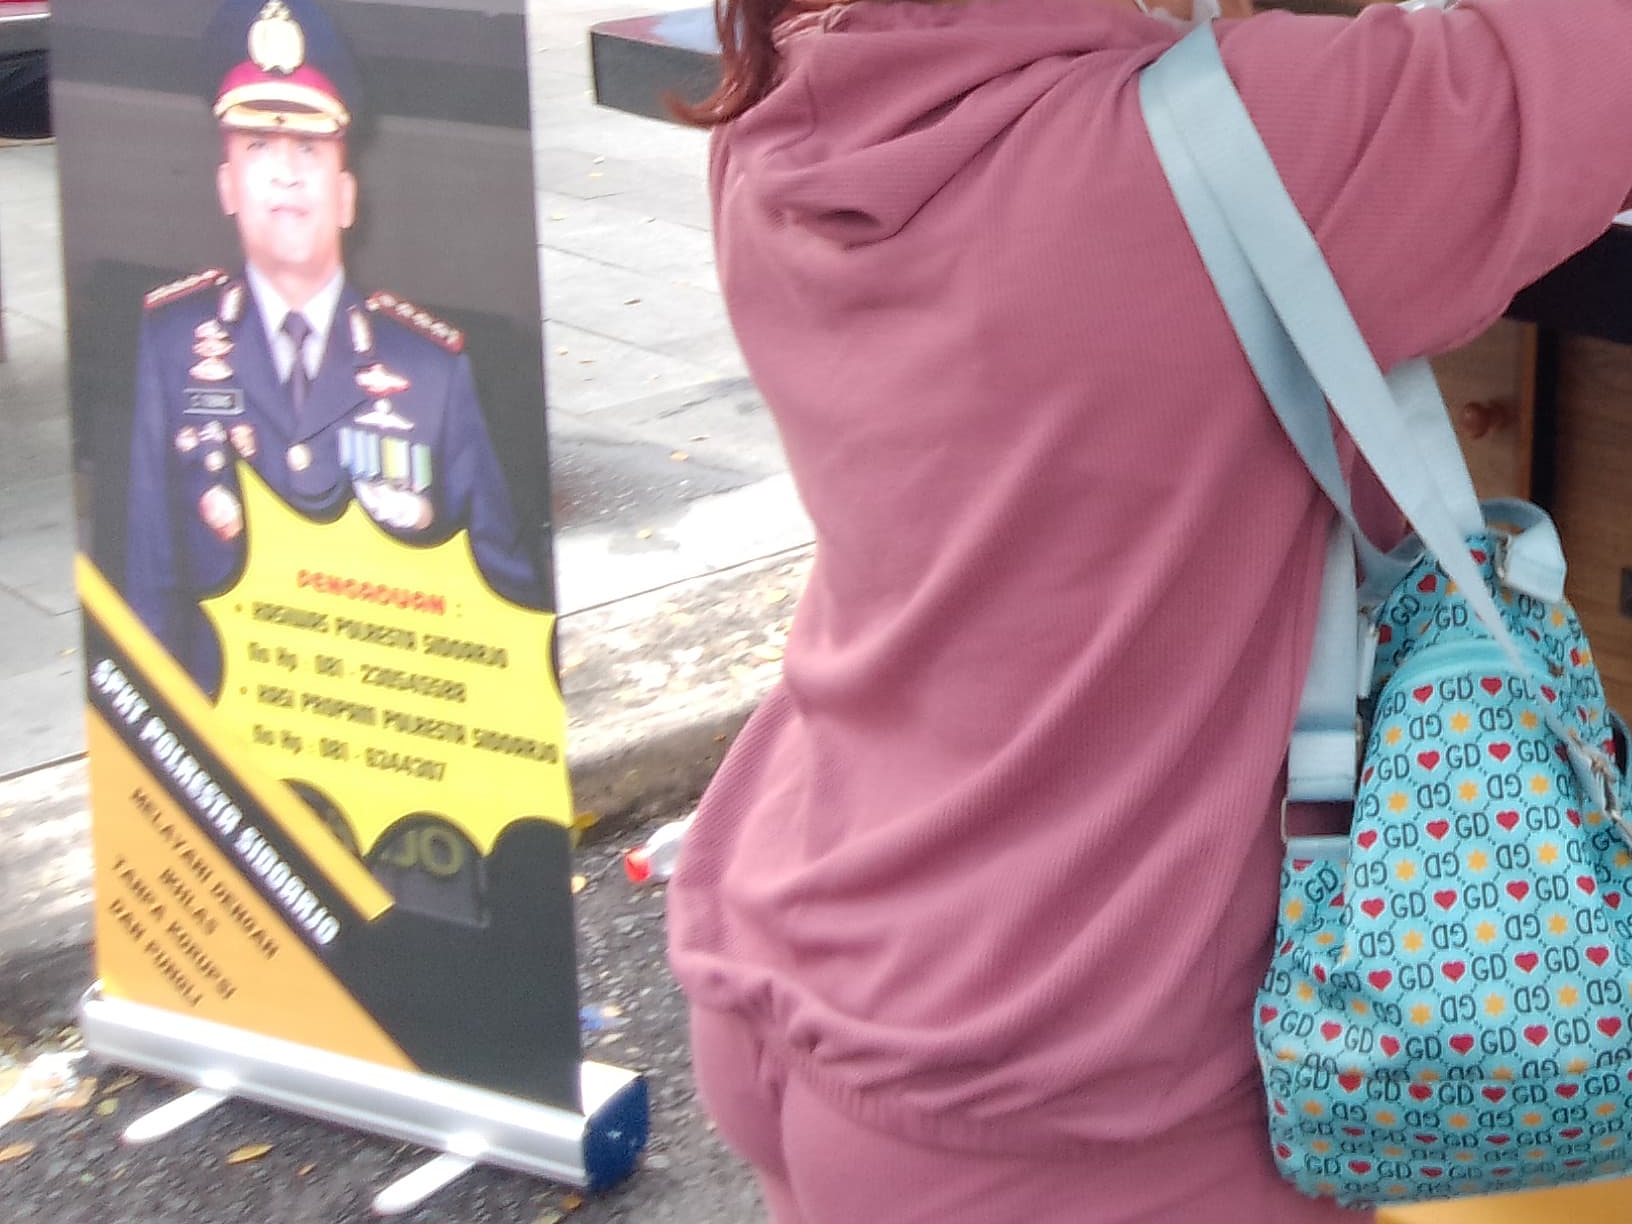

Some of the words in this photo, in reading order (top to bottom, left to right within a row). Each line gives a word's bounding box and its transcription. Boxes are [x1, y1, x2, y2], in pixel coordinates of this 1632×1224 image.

[1391, 595, 1419, 625] GD
[1436, 605, 1467, 627] GD
[1439, 677, 1473, 700] GD
[1446, 744, 1481, 769] GD
[1518, 740, 1549, 763] GD
[1378, 755, 1409, 780] GD
[1455, 812, 1489, 838] GD
[1526, 806, 1560, 830] GD
[1384, 823, 1418, 848] GD
[234, 826, 341, 946] SIDOARJO
[1304, 868, 1338, 902] GD
[1463, 882, 1499, 909] GD
[1535, 875, 1569, 901] GD
[1391, 892, 1426, 918] GD
[1472, 954, 1507, 980] GD
[1544, 946, 1579, 972] GD
[1330, 971, 1361, 992] GD
[1399, 963, 1434, 990] GD
[1280, 1011, 1314, 1037] GD
[1554, 1018, 1590, 1046] GD
[1344, 1025, 1373, 1053] GD
[1405, 1036, 1441, 1060] GD
[1481, 1026, 1516, 1055] GD
[1295, 1067, 1329, 1091] GD
[1367, 1078, 1400, 1101] GD
[1585, 1074, 1620, 1096] GD
[1439, 1082, 1474, 1105] GD
[1512, 1084, 1548, 1104] GD
[1304, 1154, 1341, 1175] GD
[1378, 1160, 1412, 1179] GD
